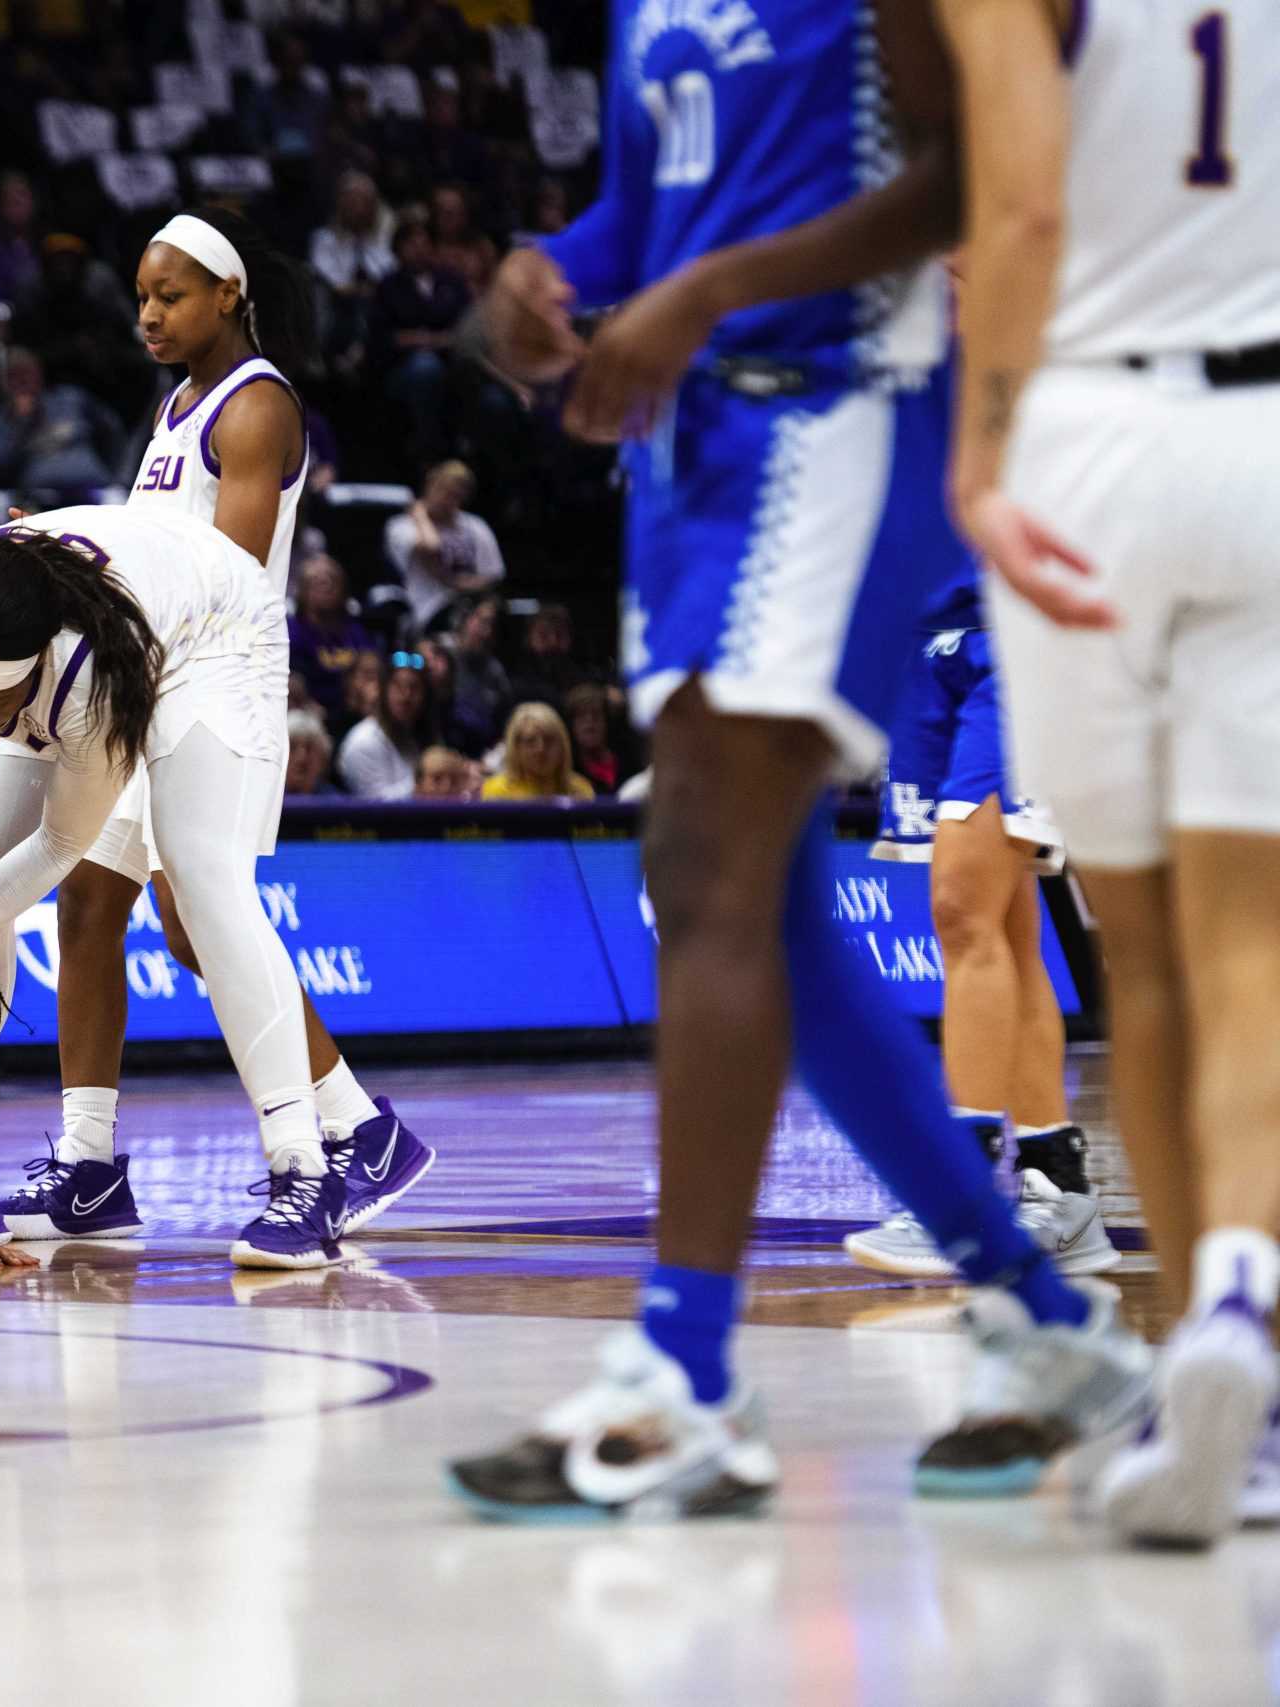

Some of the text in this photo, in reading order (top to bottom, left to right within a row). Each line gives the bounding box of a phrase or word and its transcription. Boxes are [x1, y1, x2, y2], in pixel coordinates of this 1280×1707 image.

[1184, 10, 1236, 189] 1
[136, 455, 185, 491] SU
[832, 876, 893, 923] ADY
[297, 946, 372, 996] AKE
